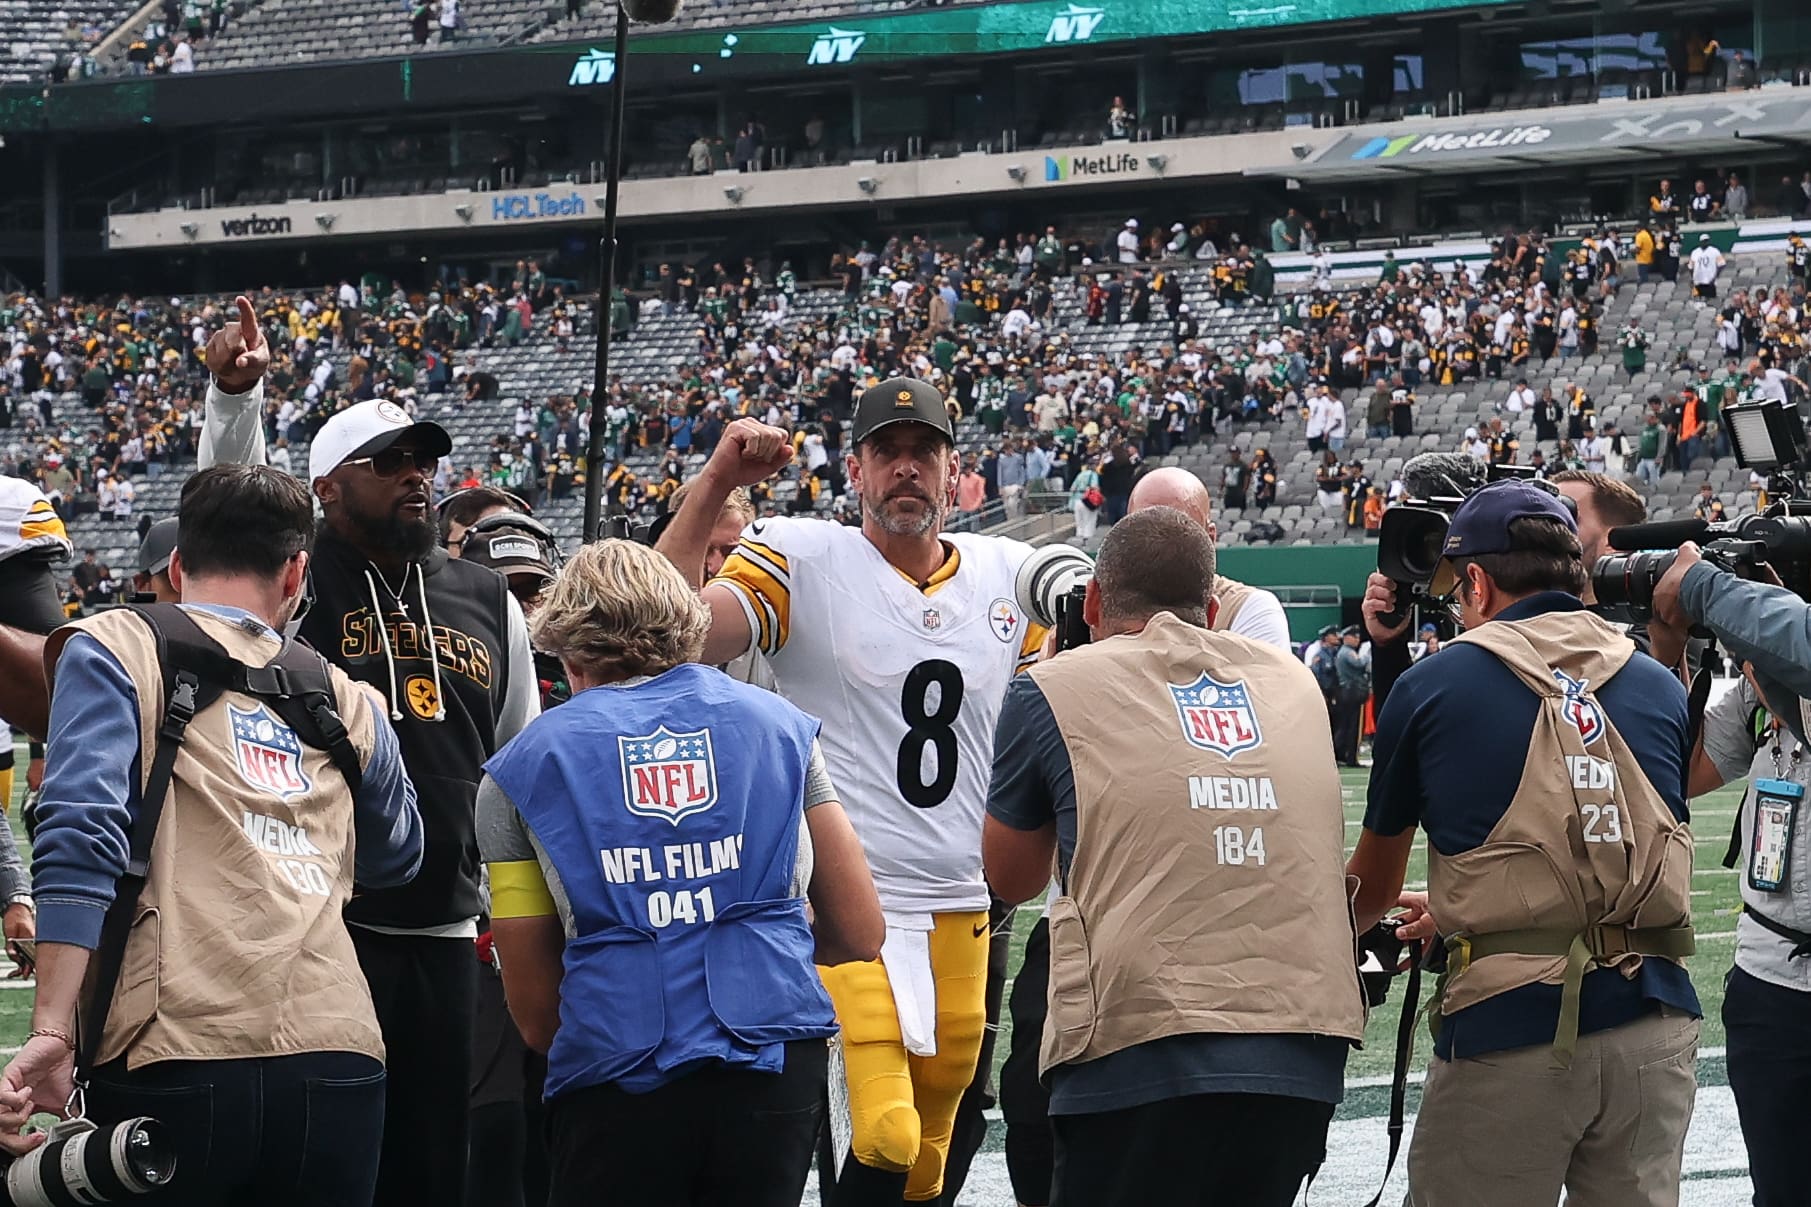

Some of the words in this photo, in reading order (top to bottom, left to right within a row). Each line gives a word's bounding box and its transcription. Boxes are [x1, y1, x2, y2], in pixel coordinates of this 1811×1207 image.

[1045, 13, 1105, 43] NY
[807, 36, 865, 65] NY
[1410, 126, 1551, 154] MetLife
[1073, 154, 1138, 175] MetLife
[221, 212, 292, 237] verizon
[341, 606, 492, 689] STEELERS
[896, 658, 965, 809] 8
[1187, 709, 1254, 746] NFL
[241, 742, 301, 789] NFL
[633, 763, 706, 809] NFL
[1188, 776, 1279, 810] MEDIA
[243, 811, 321, 856] MEDIA
[1213, 825, 1266, 866] 184
[277, 859, 331, 897] 130
[600, 847, 662, 884] NFL
[647, 886, 715, 928] 041
